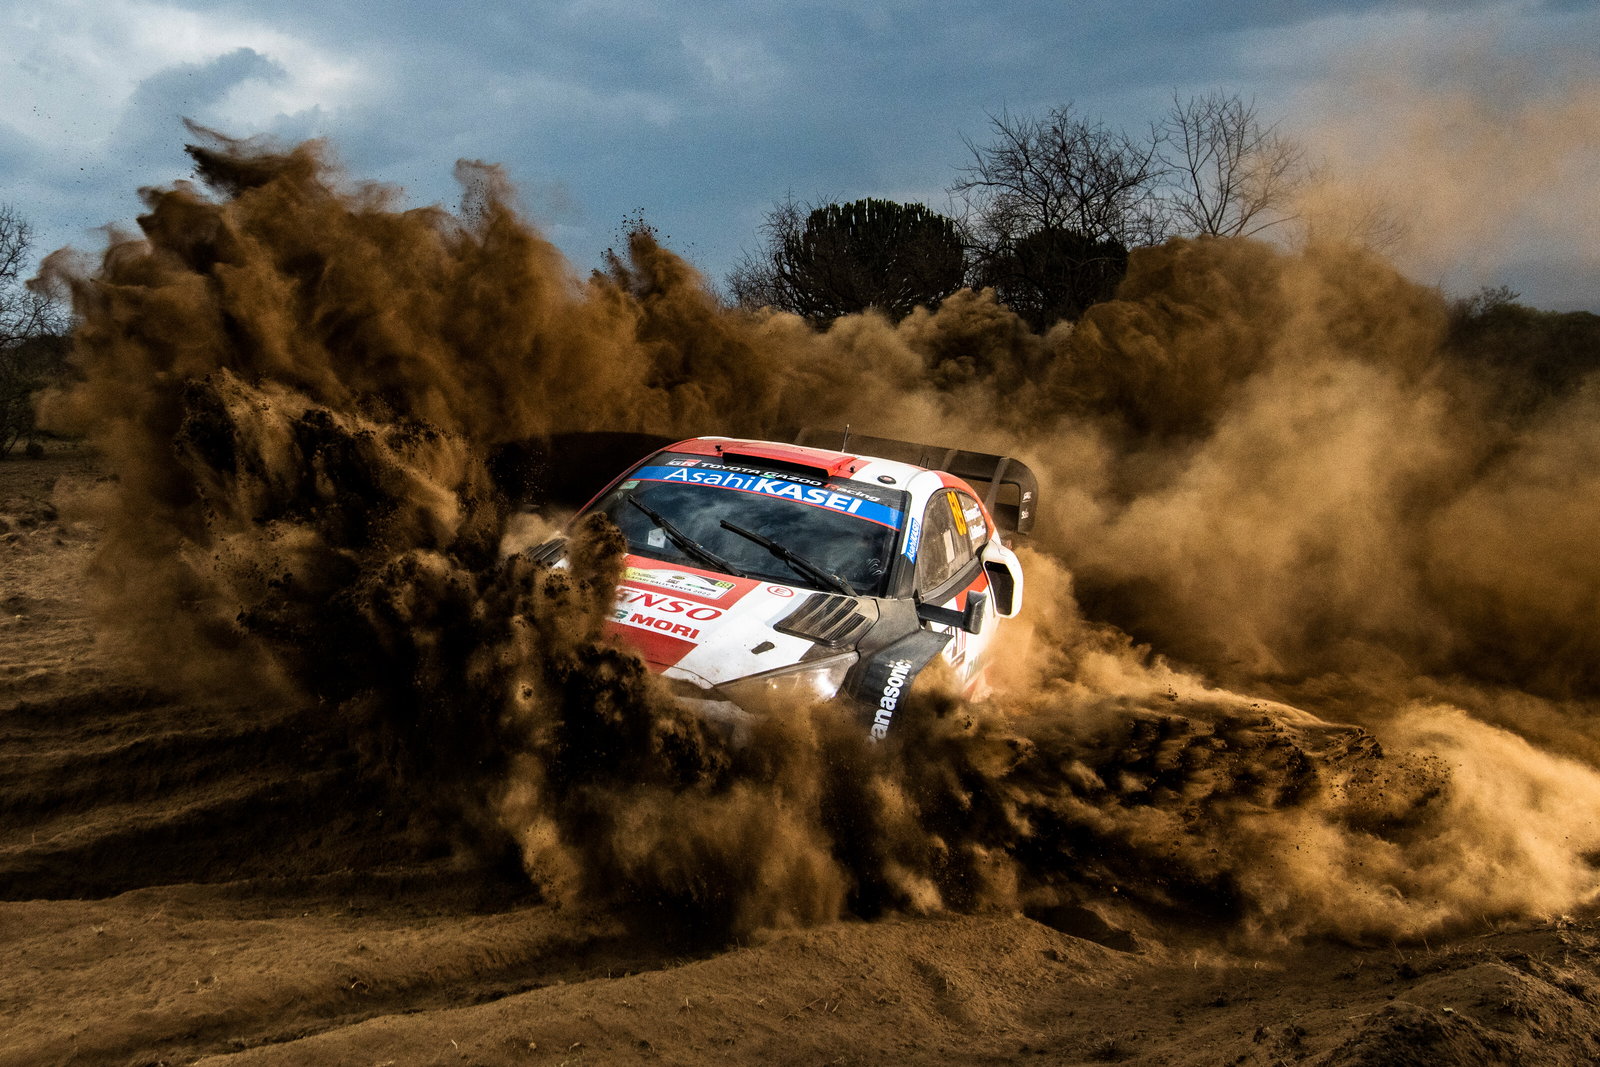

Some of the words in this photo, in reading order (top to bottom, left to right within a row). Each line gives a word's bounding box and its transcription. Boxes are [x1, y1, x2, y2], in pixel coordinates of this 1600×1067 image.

[700, 462, 761, 474] TOYOTA
[761, 471, 822, 486] GAZOO
[824, 483, 881, 502] Racing
[629, 612, 701, 640] MORI
[867, 659, 912, 743] anasonic
